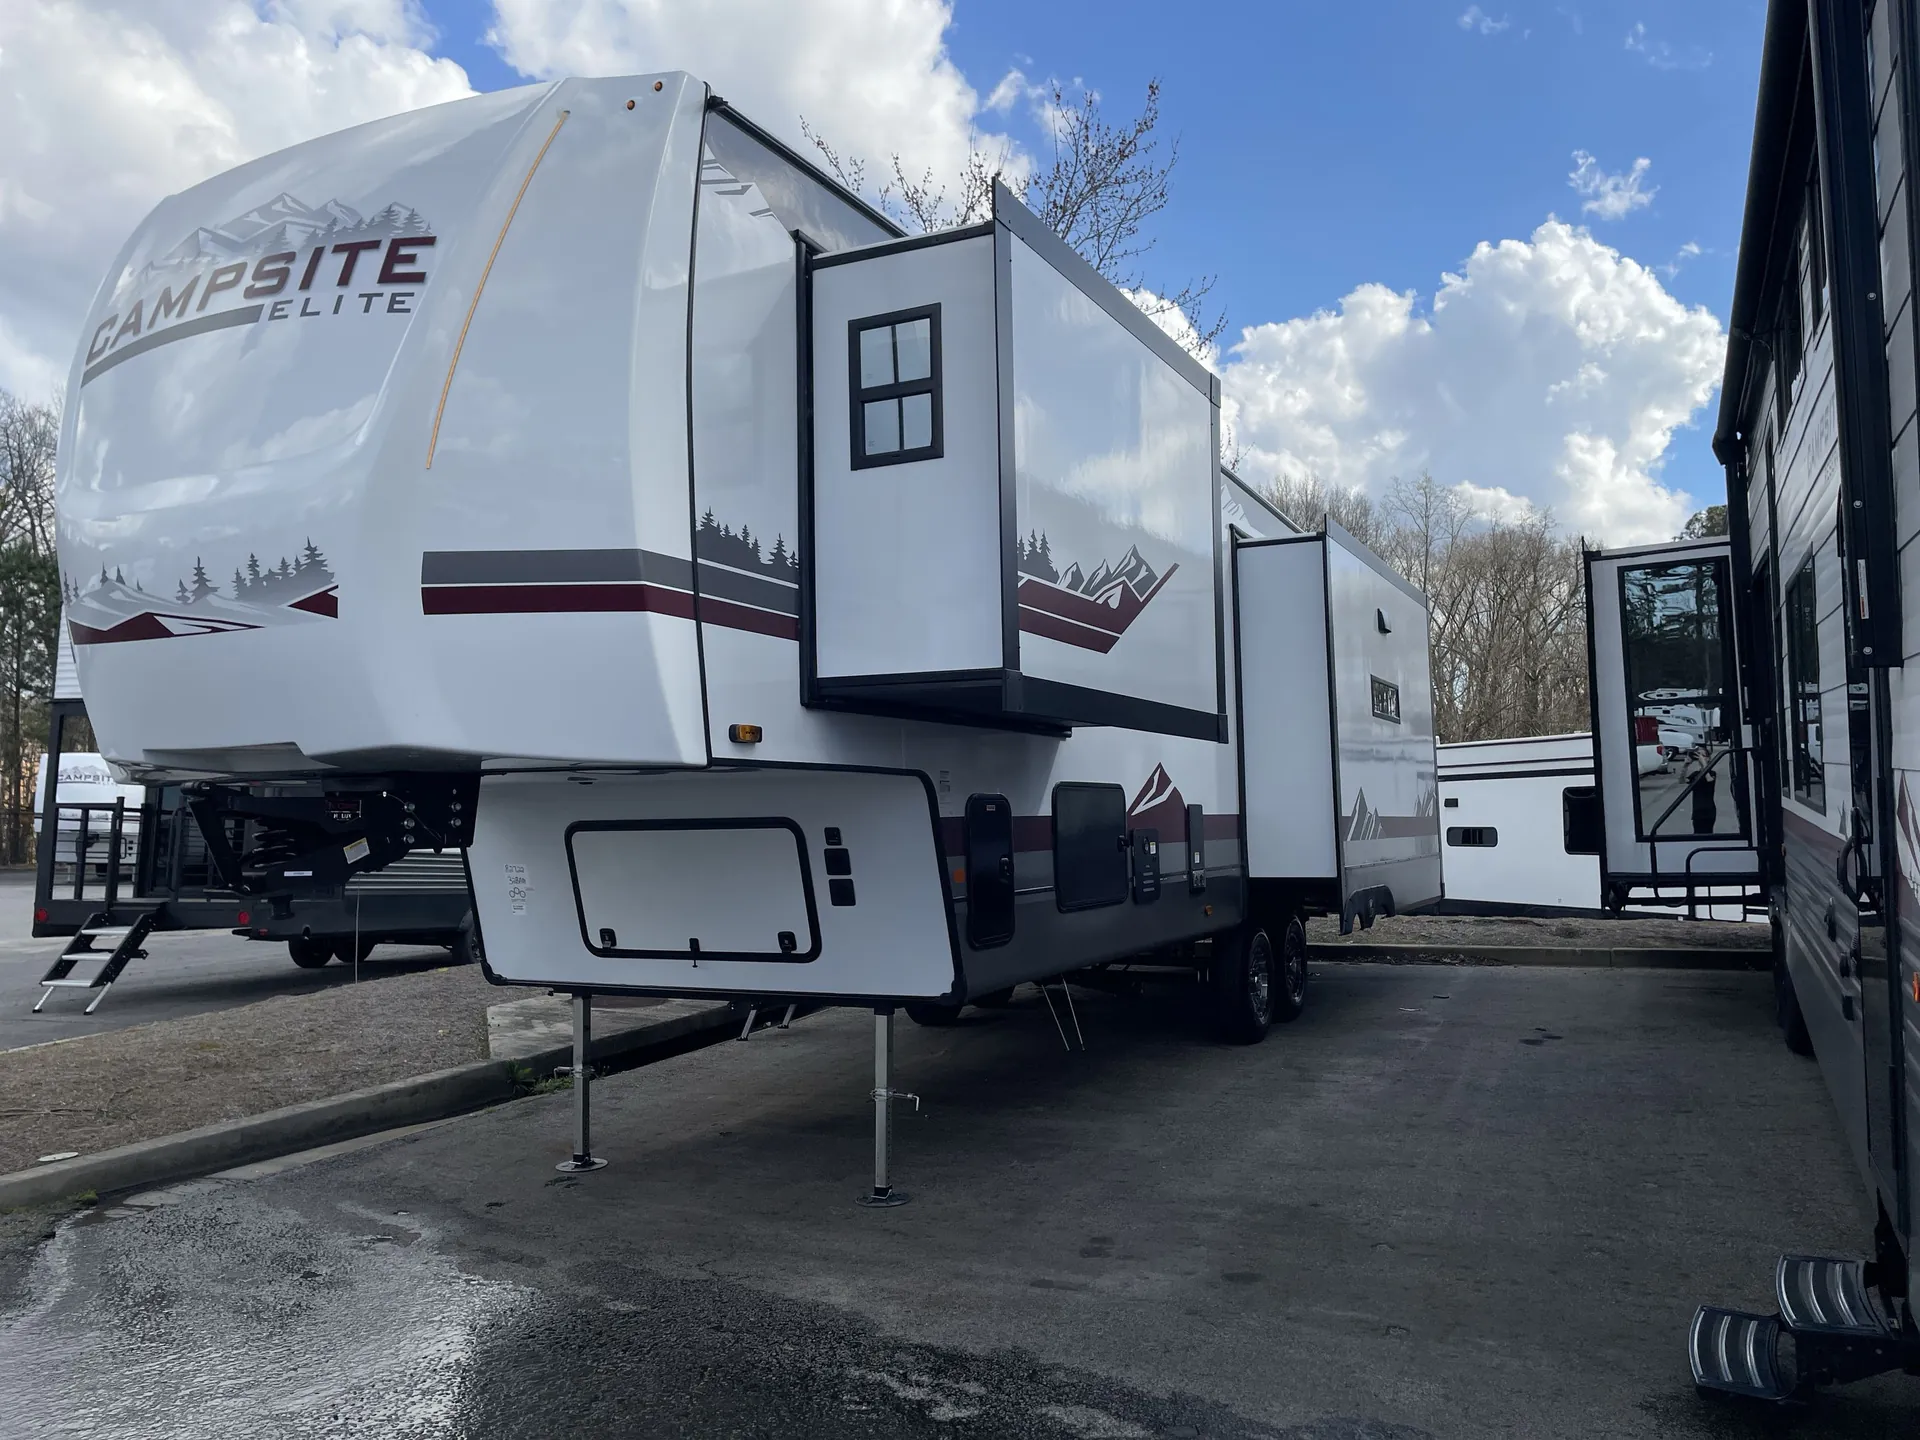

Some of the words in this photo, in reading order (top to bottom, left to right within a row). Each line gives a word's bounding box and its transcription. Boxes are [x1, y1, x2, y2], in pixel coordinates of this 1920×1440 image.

[86, 236, 437, 365] CAMPSITE
[268, 292, 415, 321] ELITE
[58, 774, 113, 782] CAMPSIT
